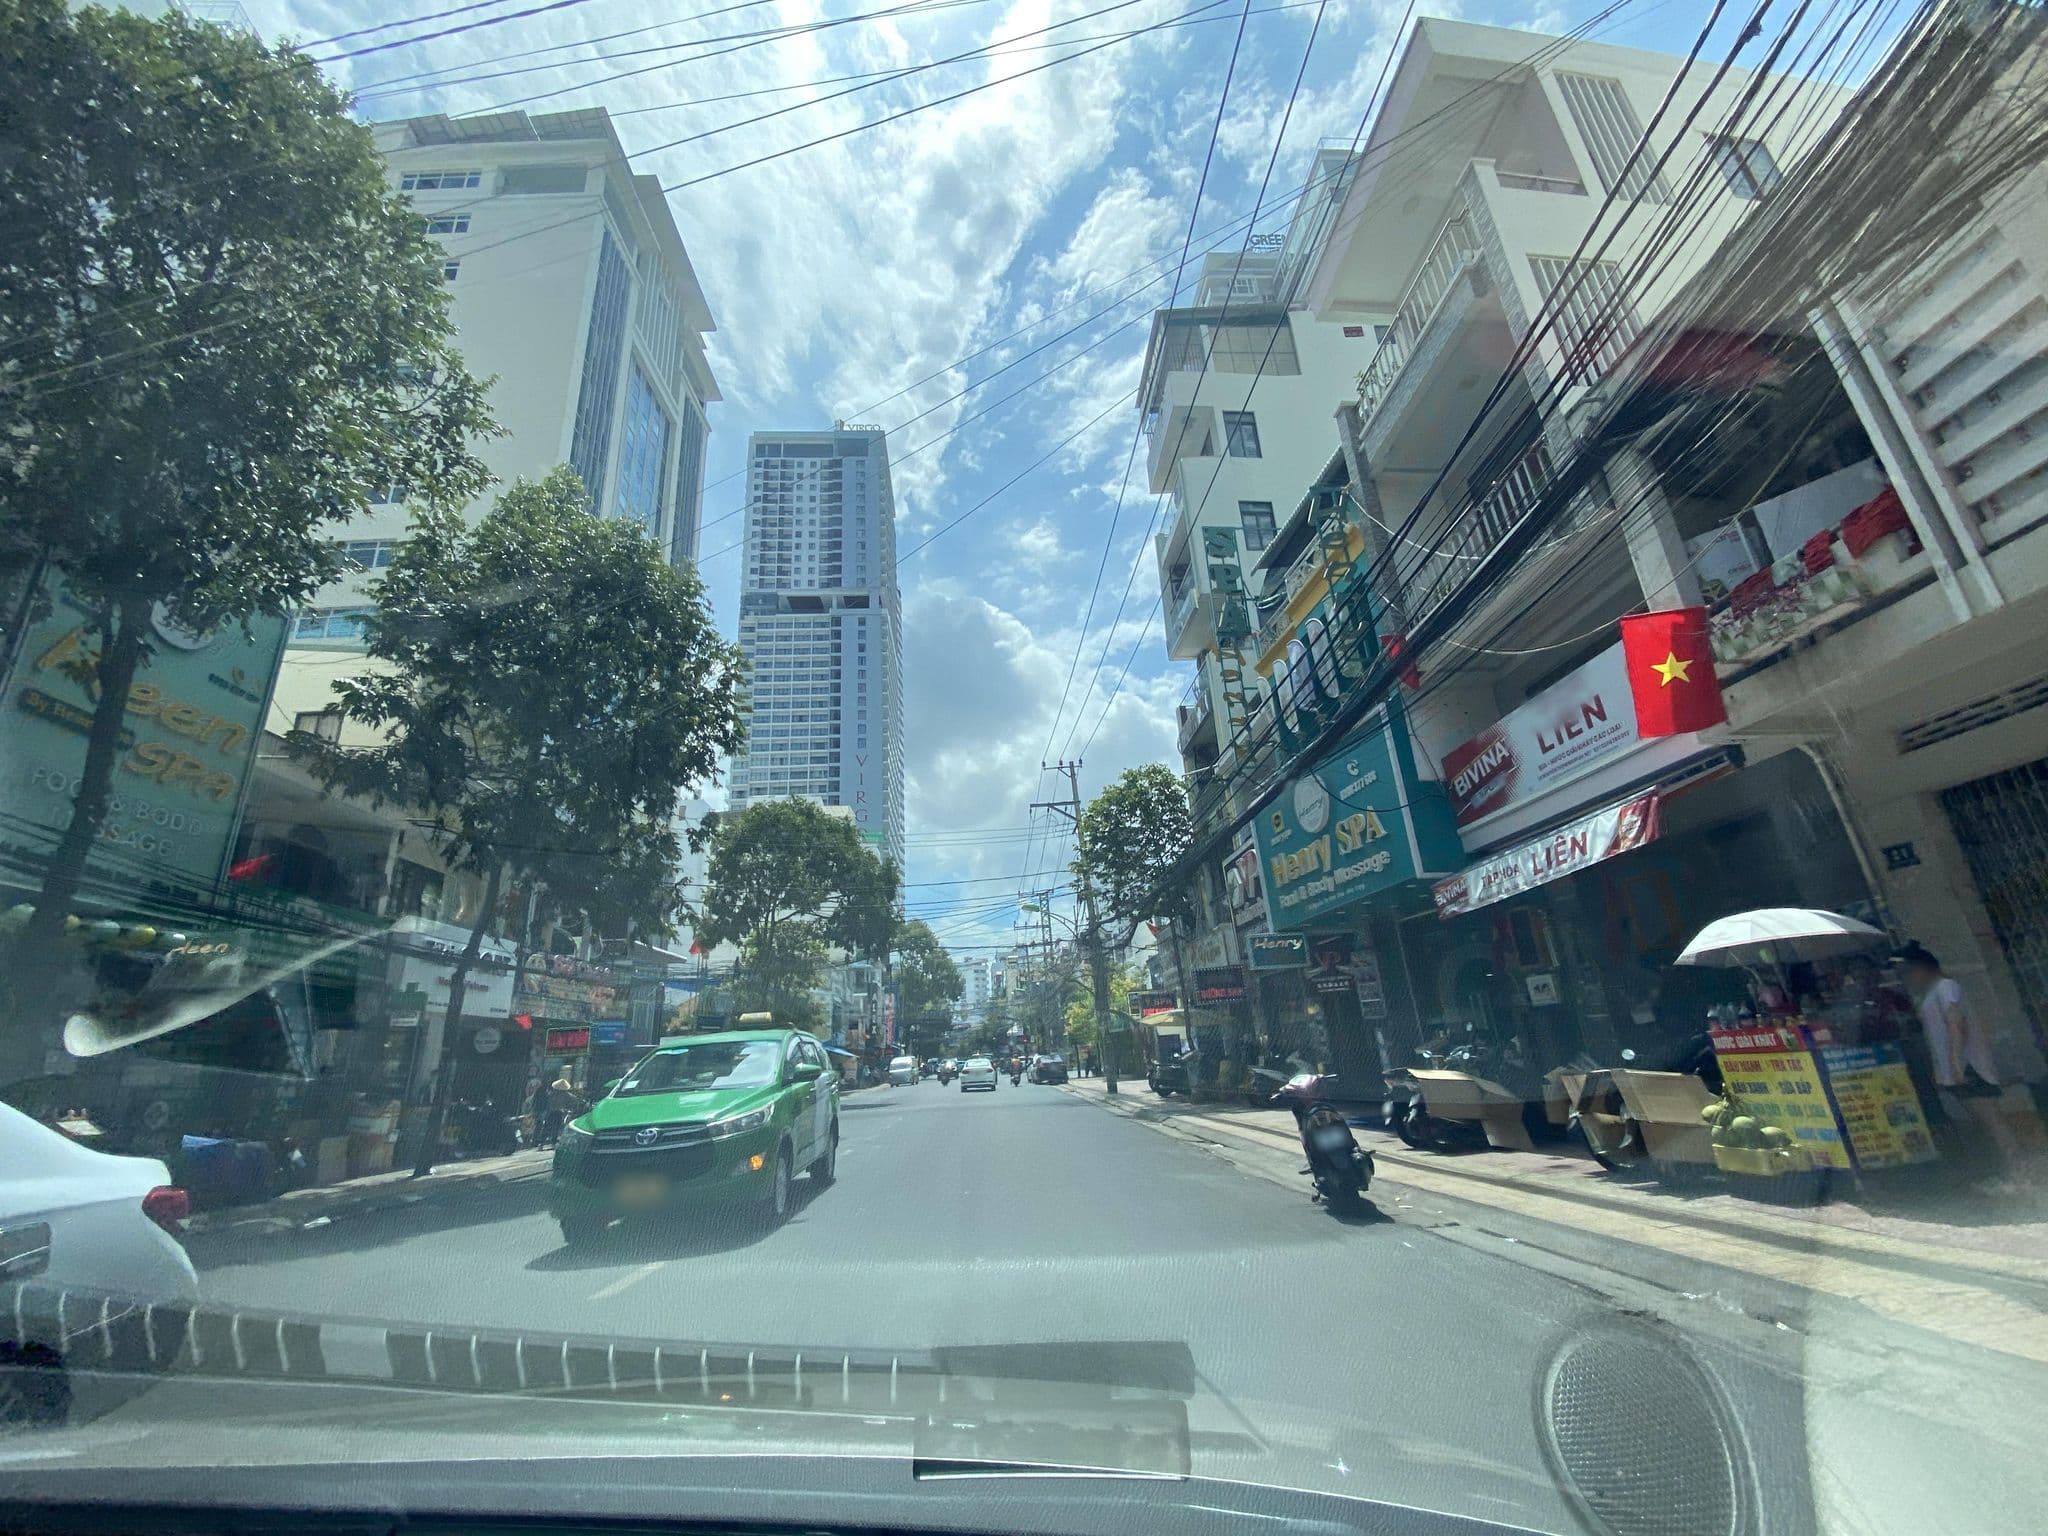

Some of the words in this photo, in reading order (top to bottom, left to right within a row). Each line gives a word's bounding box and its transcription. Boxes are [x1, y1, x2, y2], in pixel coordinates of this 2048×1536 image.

[1454, 741, 1510, 797] BIVINA
[1336, 805, 1389, 855] SPA
[1531, 831, 1587, 876] LIÊN
